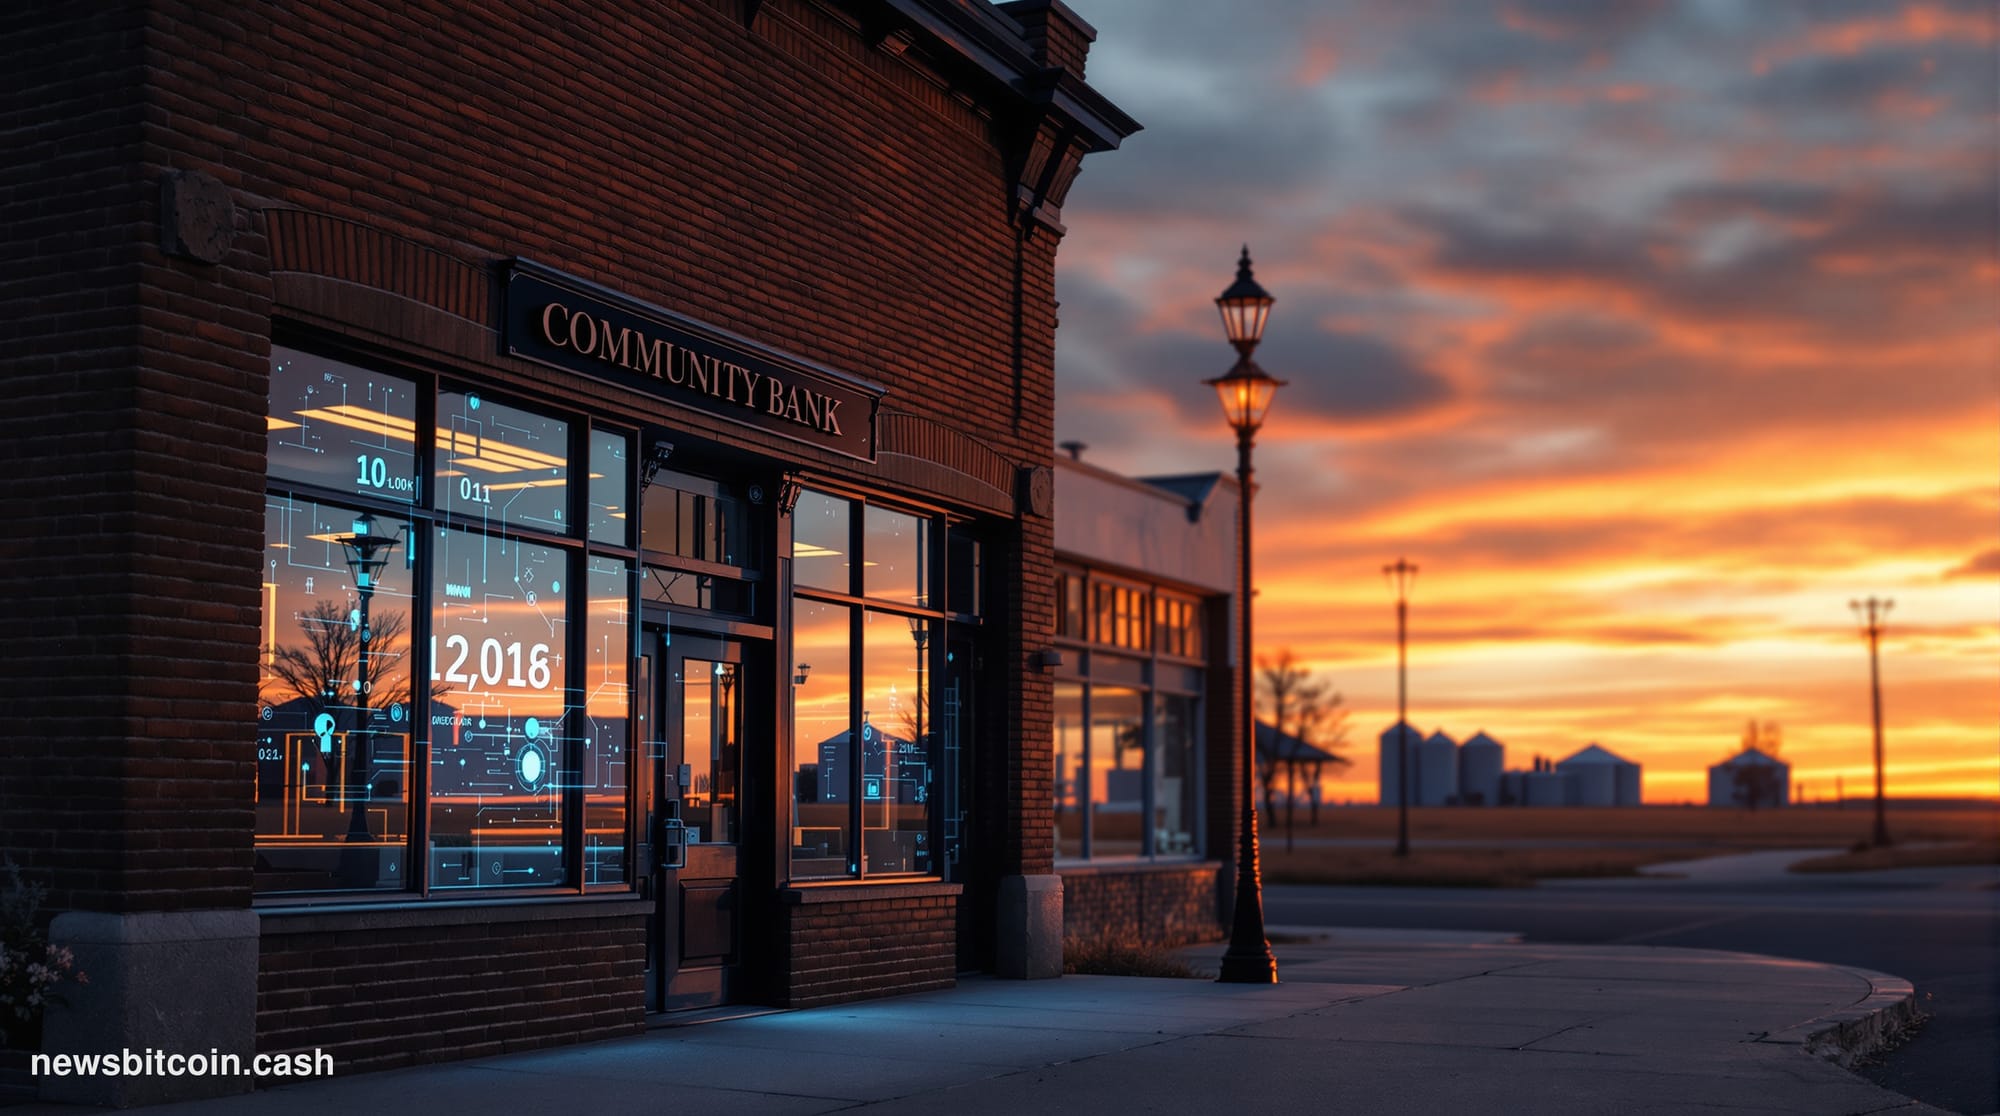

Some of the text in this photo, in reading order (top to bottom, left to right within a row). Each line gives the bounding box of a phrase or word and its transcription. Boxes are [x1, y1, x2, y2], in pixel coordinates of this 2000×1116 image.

[542, 301, 843, 437] COMMUNITY BANK
[356, 454, 387, 489] 10
[460, 477, 491, 503] 011
